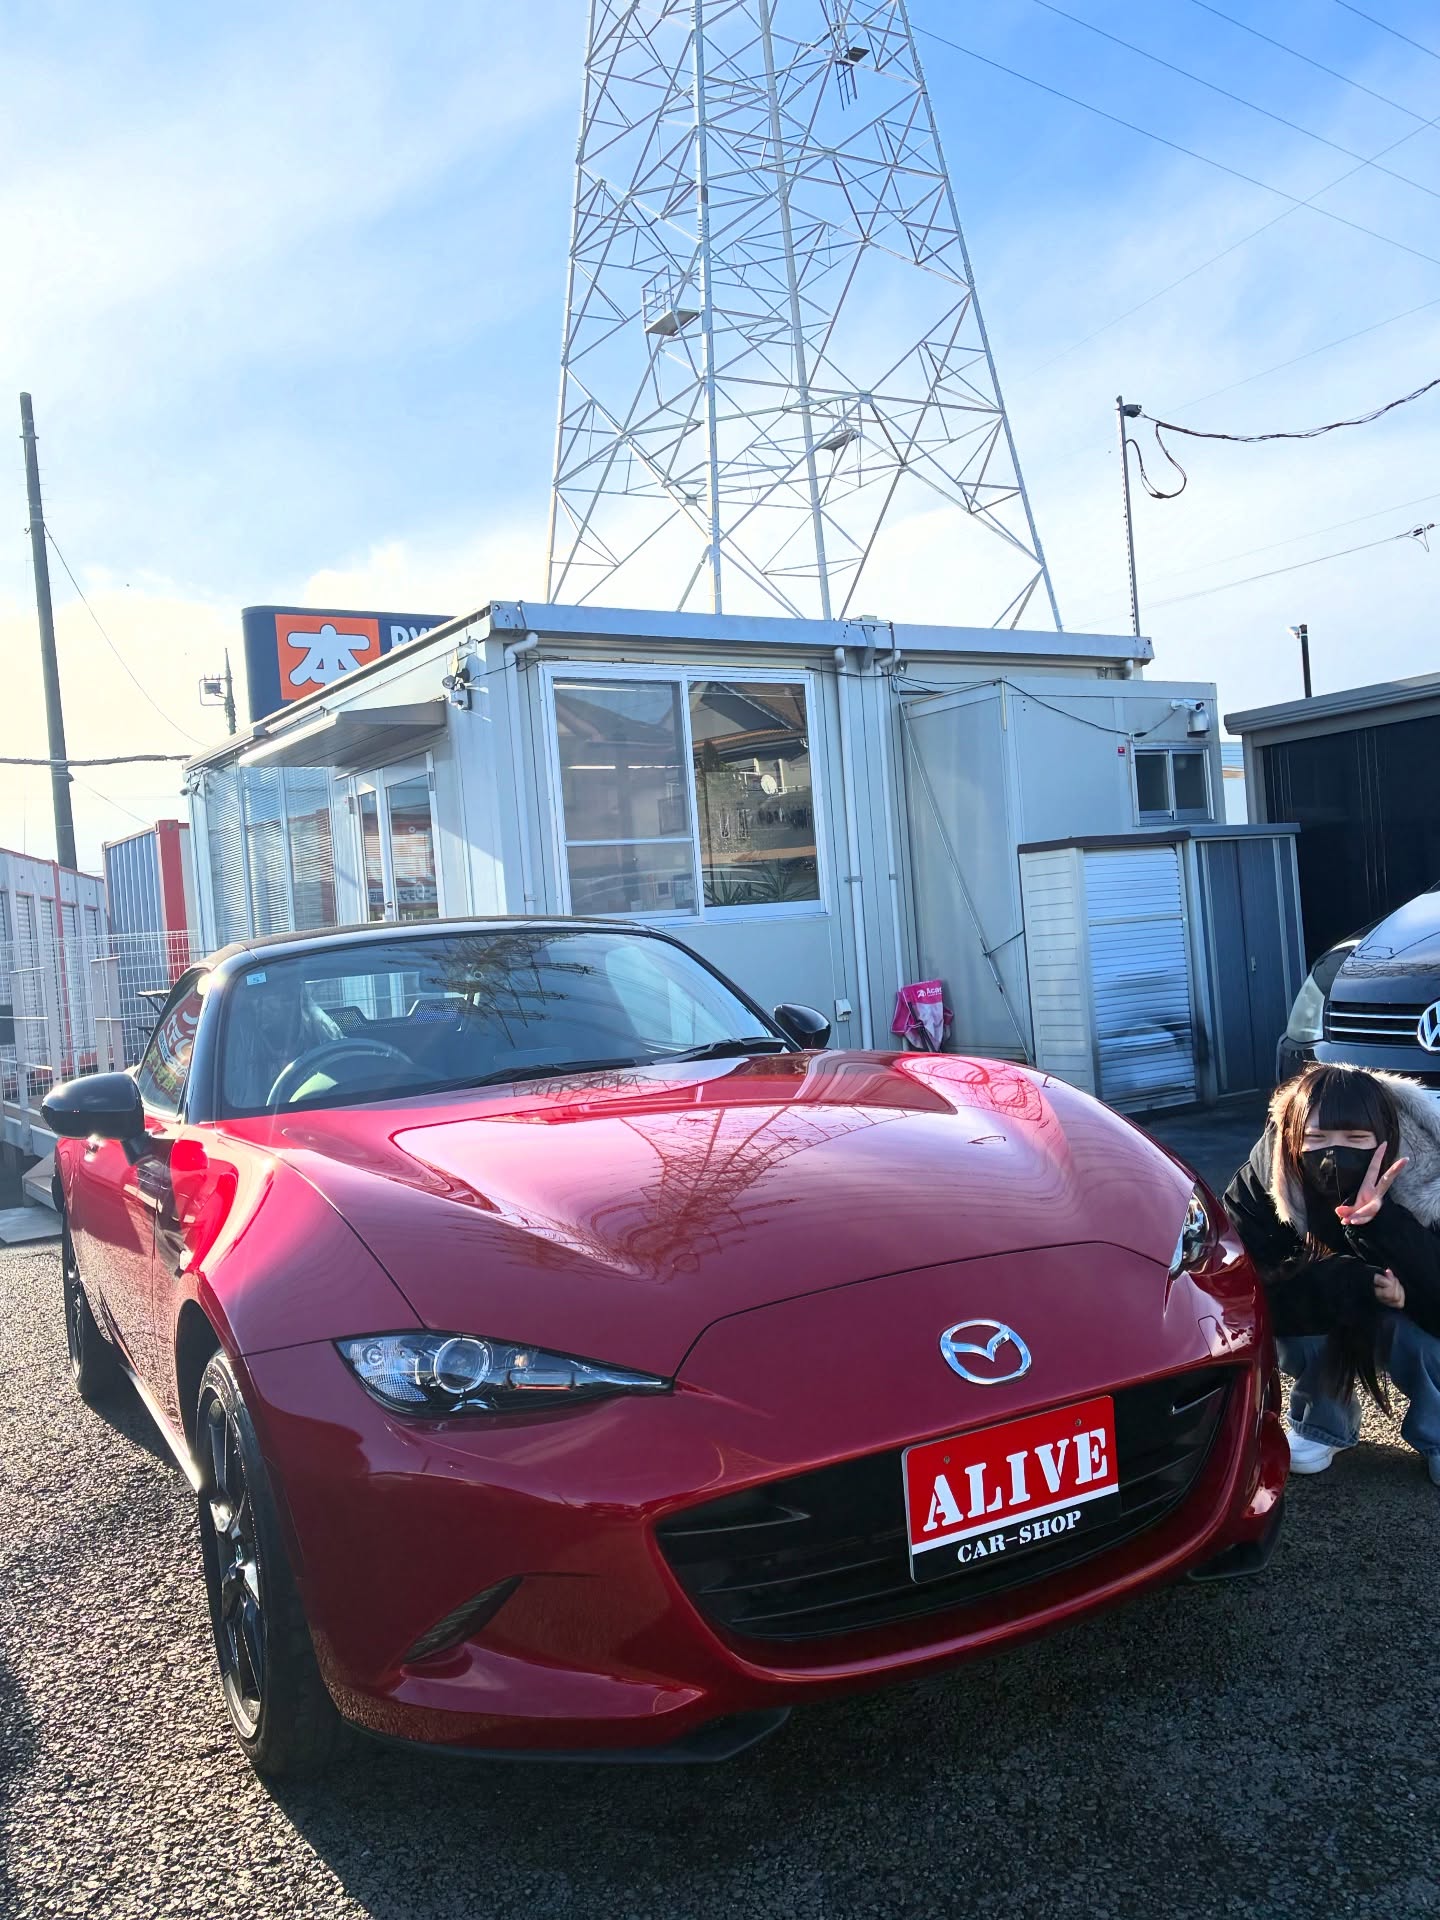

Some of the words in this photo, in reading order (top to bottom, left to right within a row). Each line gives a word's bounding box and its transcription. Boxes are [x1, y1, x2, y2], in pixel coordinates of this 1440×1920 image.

[287, 623, 370, 687] 本
[923, 1428, 1108, 1532] ALIVE
[957, 1510, 1082, 1563] CAR-SHOP
